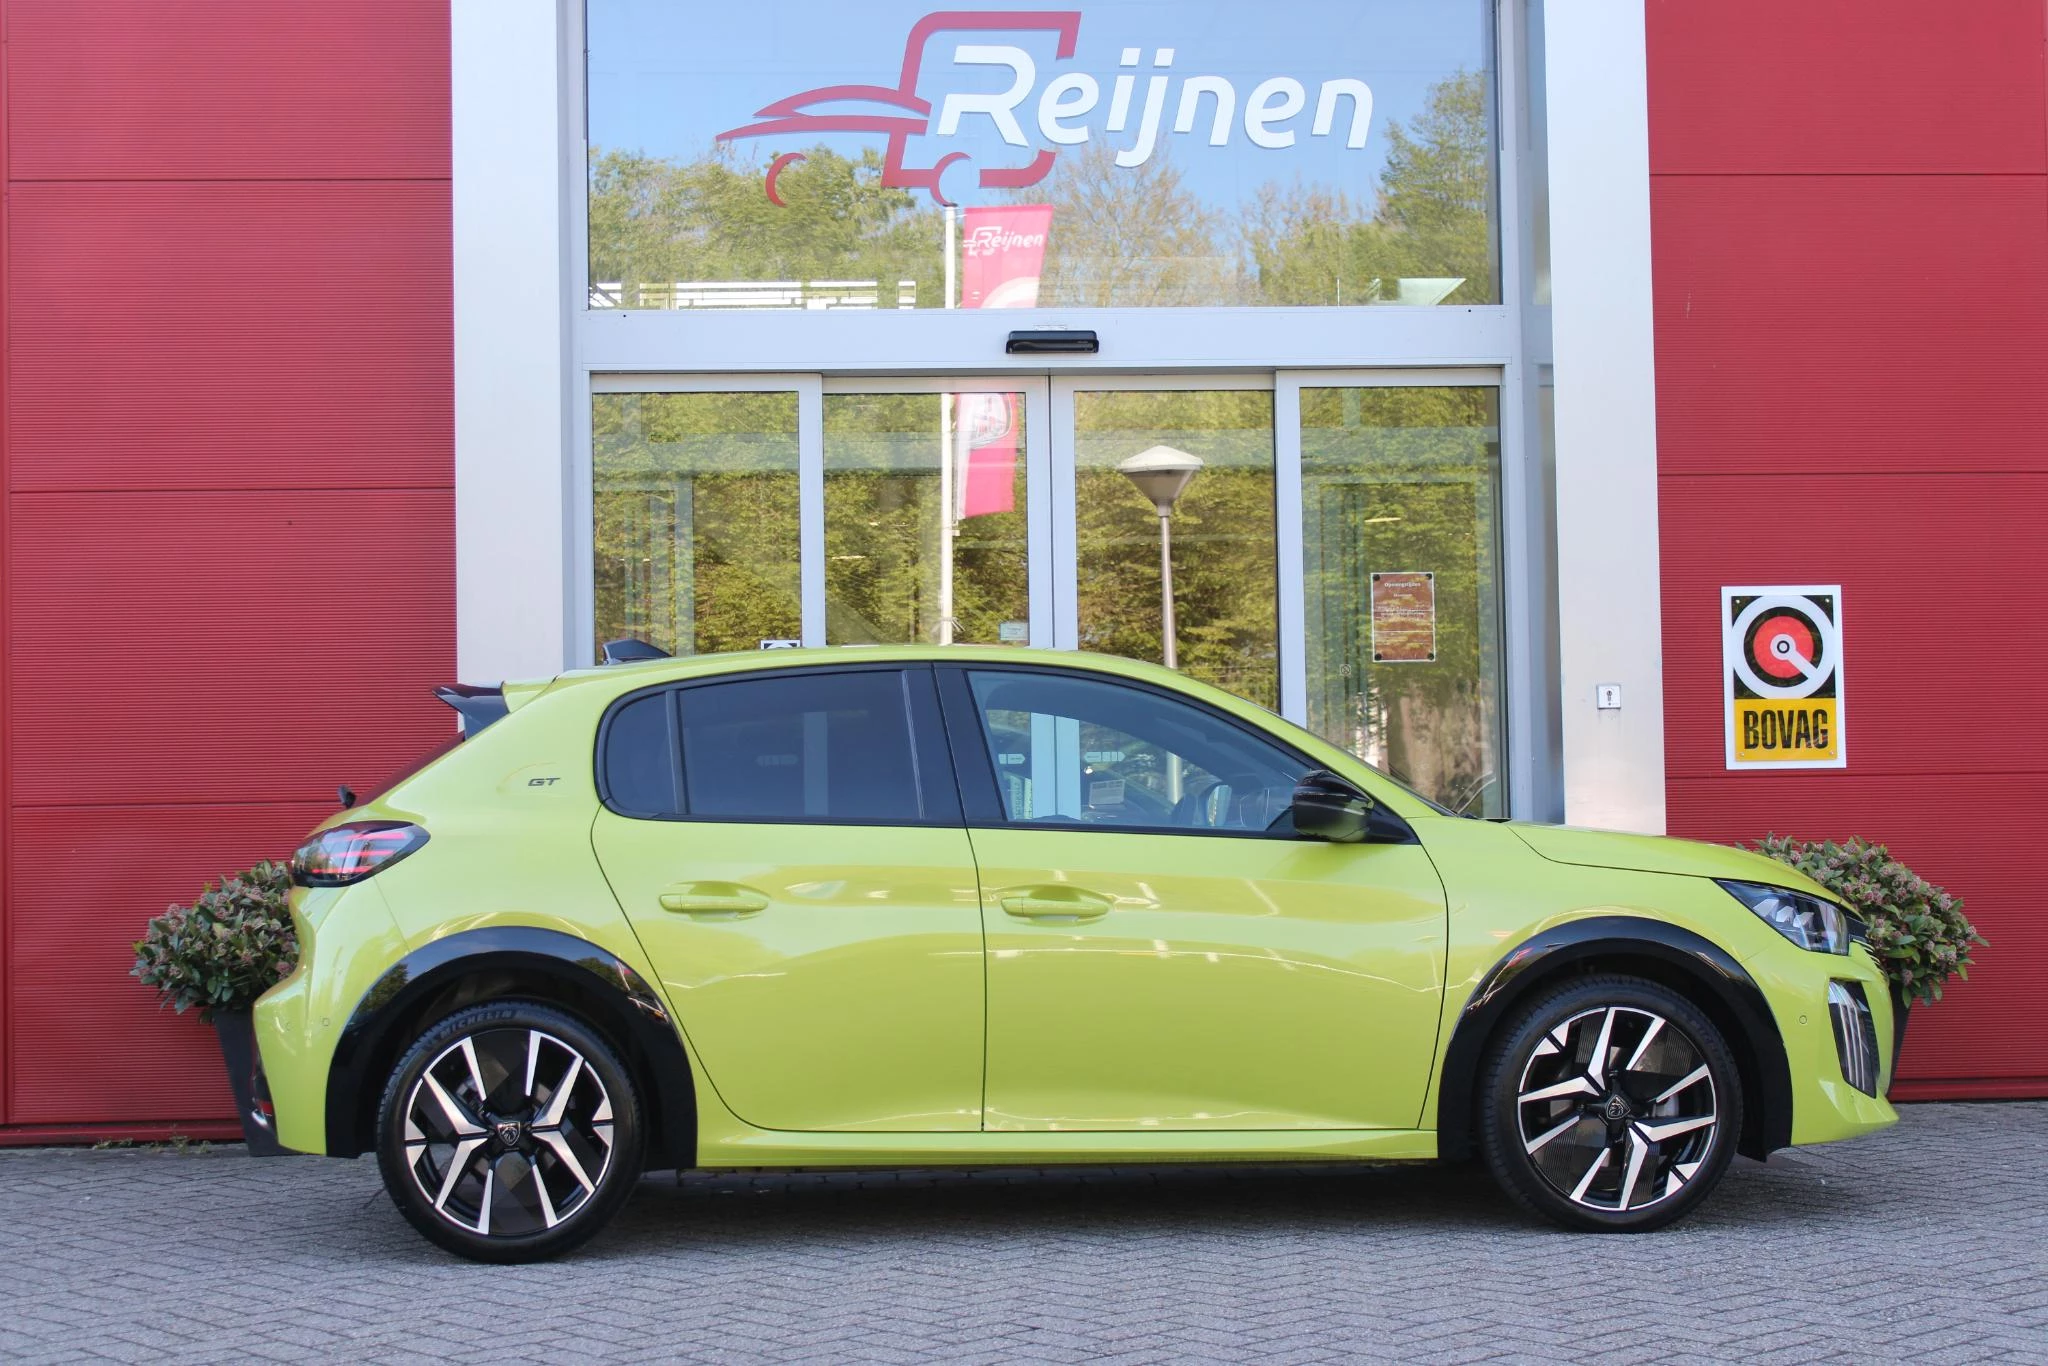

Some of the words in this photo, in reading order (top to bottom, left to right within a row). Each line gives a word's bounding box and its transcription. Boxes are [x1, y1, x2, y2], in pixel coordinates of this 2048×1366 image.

[936, 45, 1374, 168] Reijnen
[977, 231, 1044, 252] Reijnen
[1743, 709, 1828, 749] BOVAG
[528, 777, 561, 786] GT
[440, 1010, 512, 1039] MICHELIN
